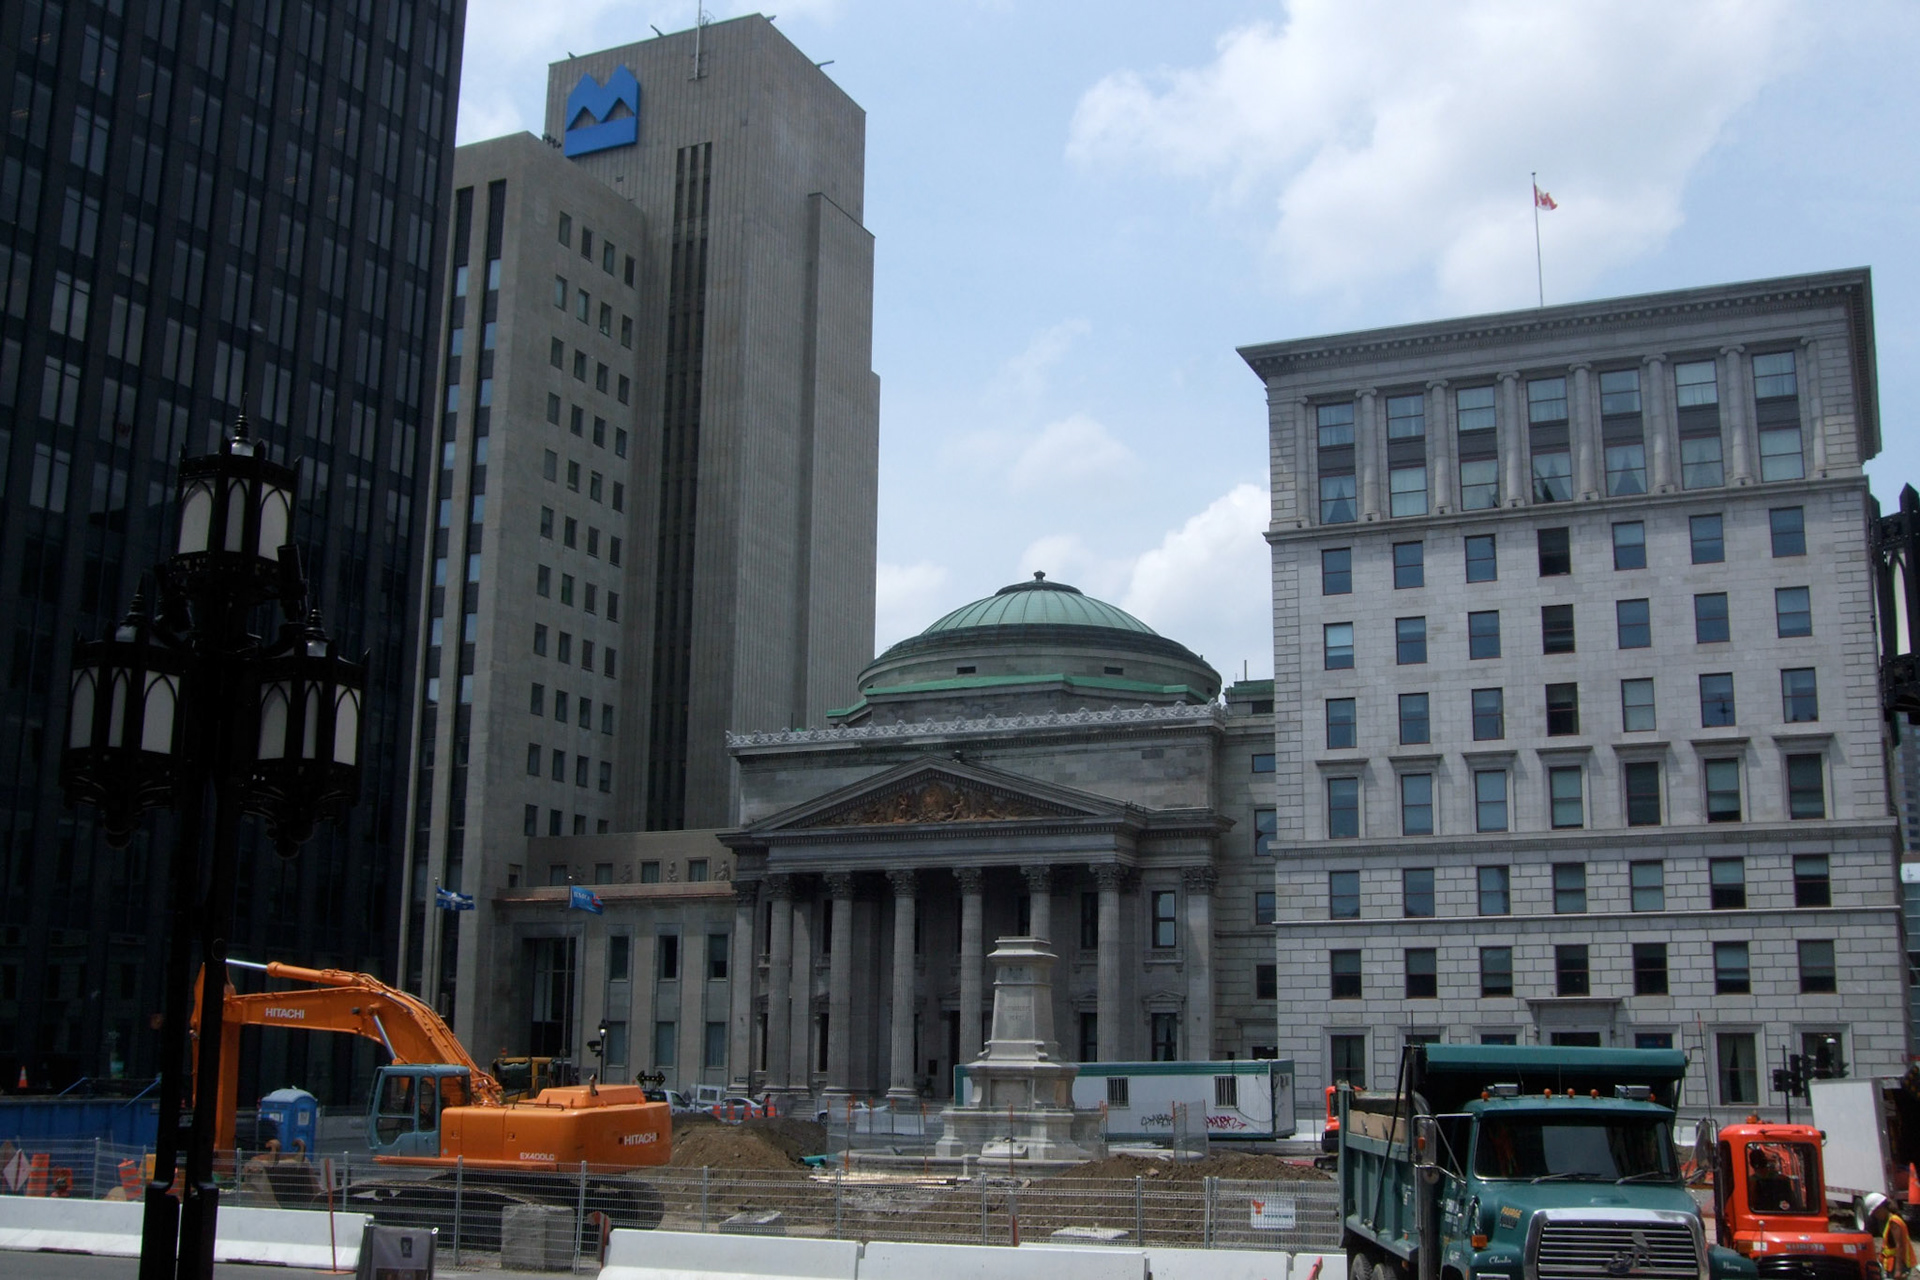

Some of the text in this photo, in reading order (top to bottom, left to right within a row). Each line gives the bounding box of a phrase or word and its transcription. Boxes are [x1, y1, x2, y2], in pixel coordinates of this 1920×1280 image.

[265, 1007, 305, 1019] HITACHI
[624, 1132, 657, 1145] HITACHI
[519, 1152, 555, 1161] EX400LC
